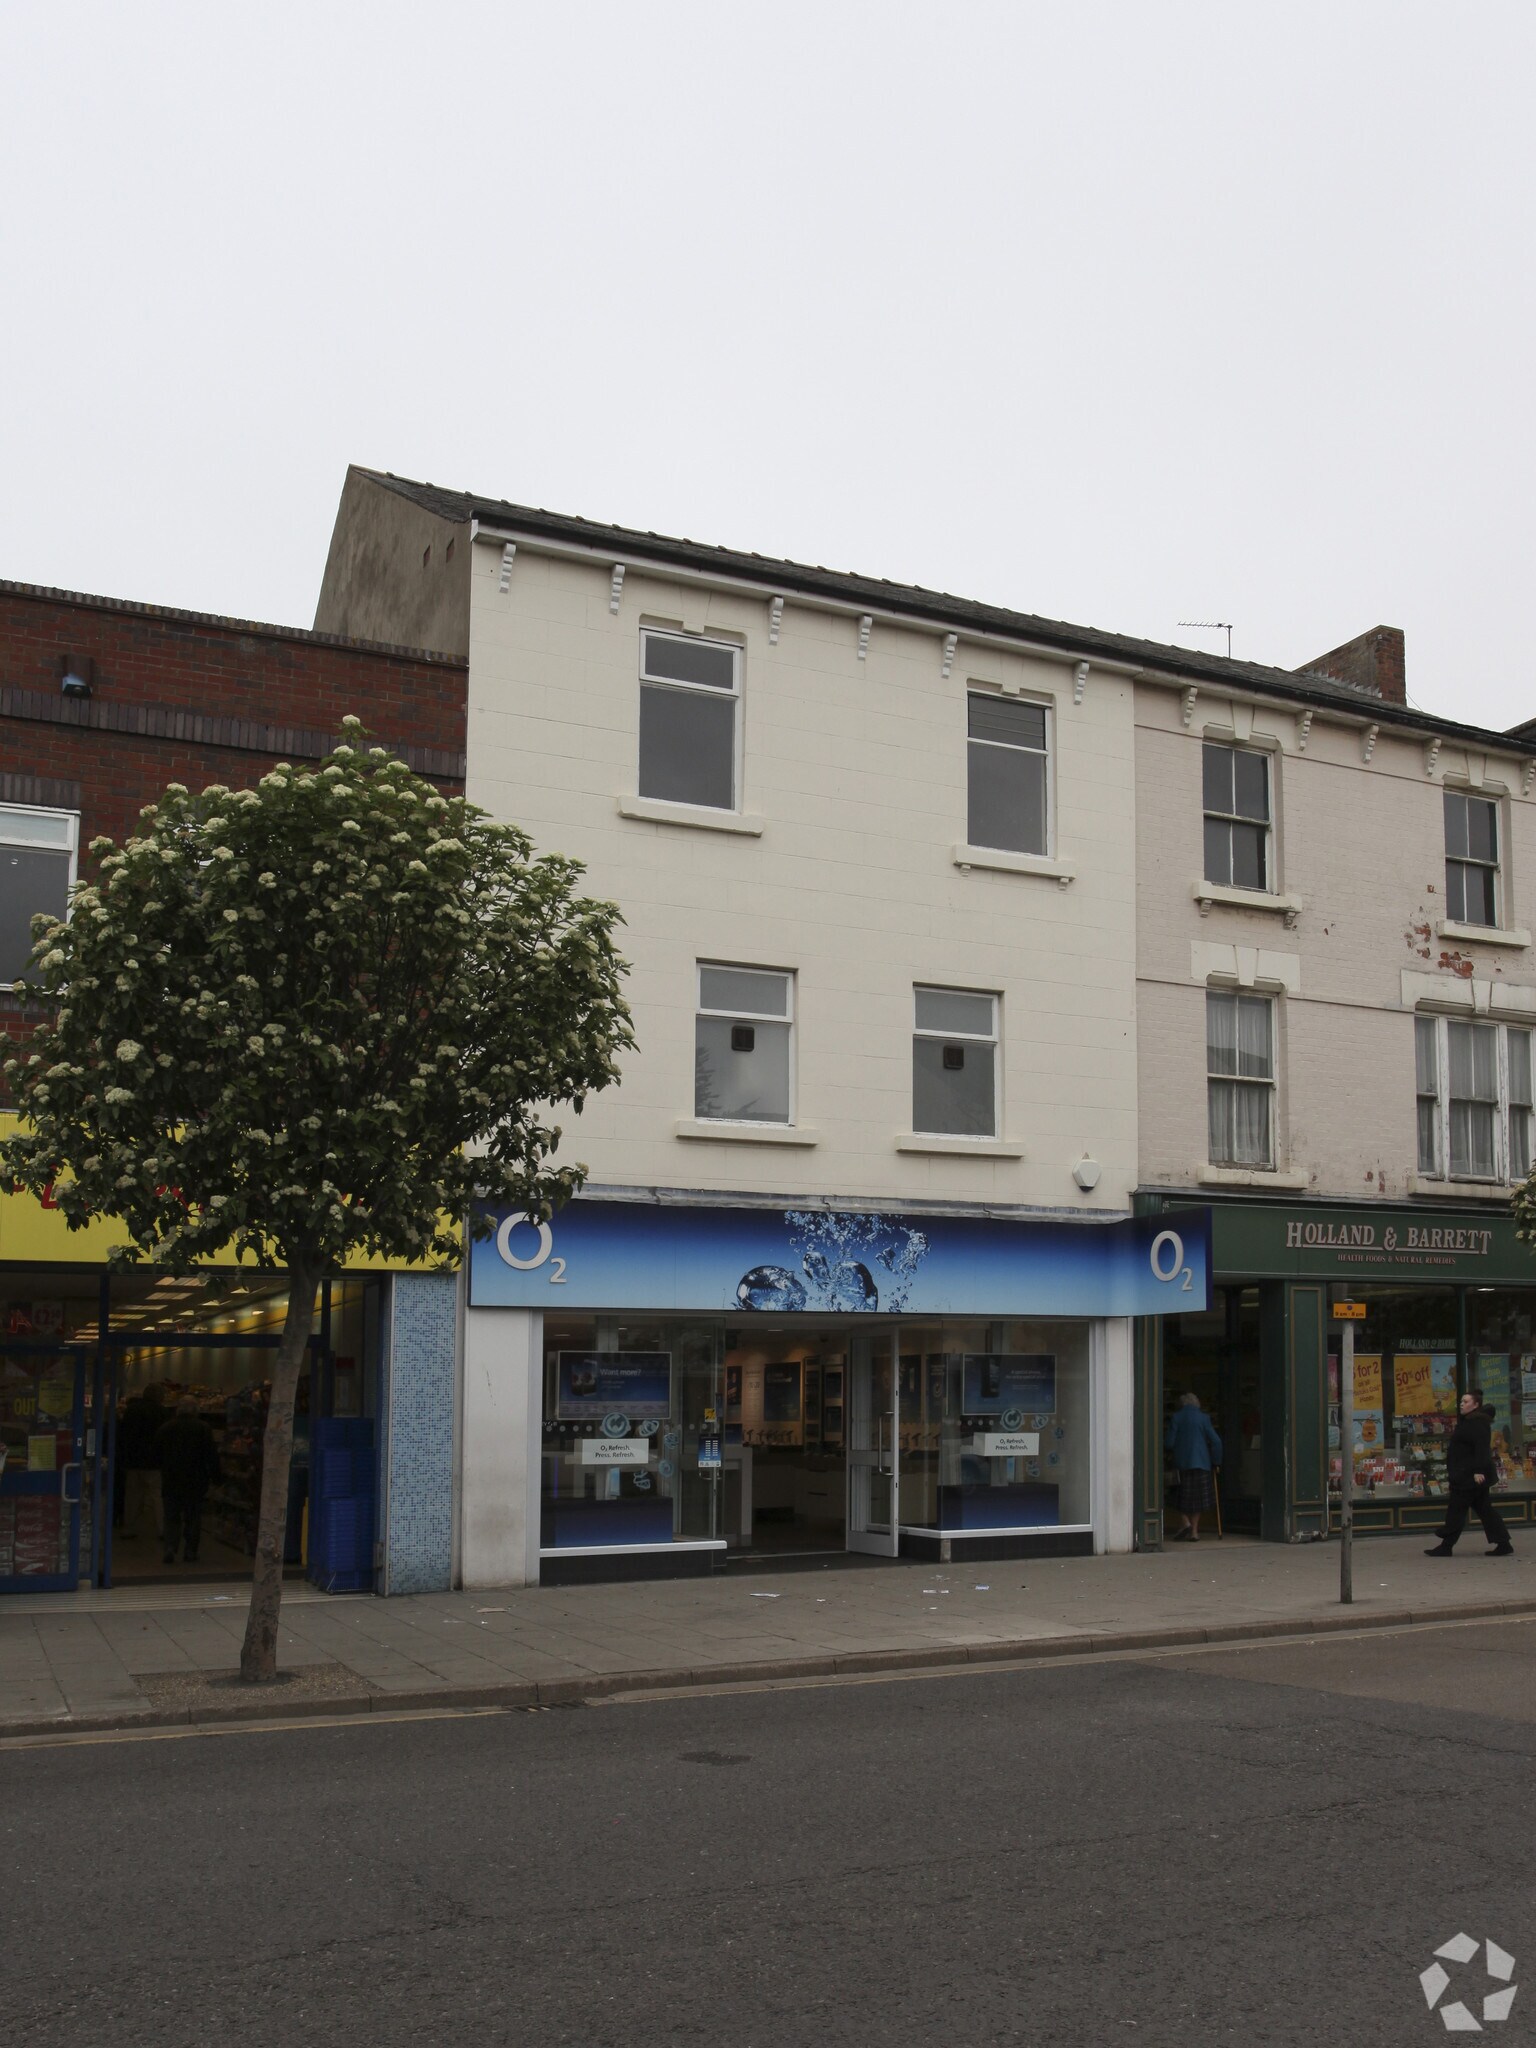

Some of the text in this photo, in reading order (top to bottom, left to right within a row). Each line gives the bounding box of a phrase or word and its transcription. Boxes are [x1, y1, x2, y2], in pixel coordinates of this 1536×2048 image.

[1286, 1221, 1492, 1255] HOLLAND & BARRETT
[1150, 1230, 1193, 1291] O2
[1337, 1253, 1364, 1262] HEALTH
[1365, 1254, 1386, 1263] FOODS
[1394, 1255, 1423, 1264] NATURAL
[1425, 1256, 1456, 1265] REMEDIES
[599, 1368, 642, 1376] Want more?
[1357, 1364, 1372, 1378] for
[1373, 1361, 1379, 1375] 2
[1414, 1365, 1430, 1382] off
